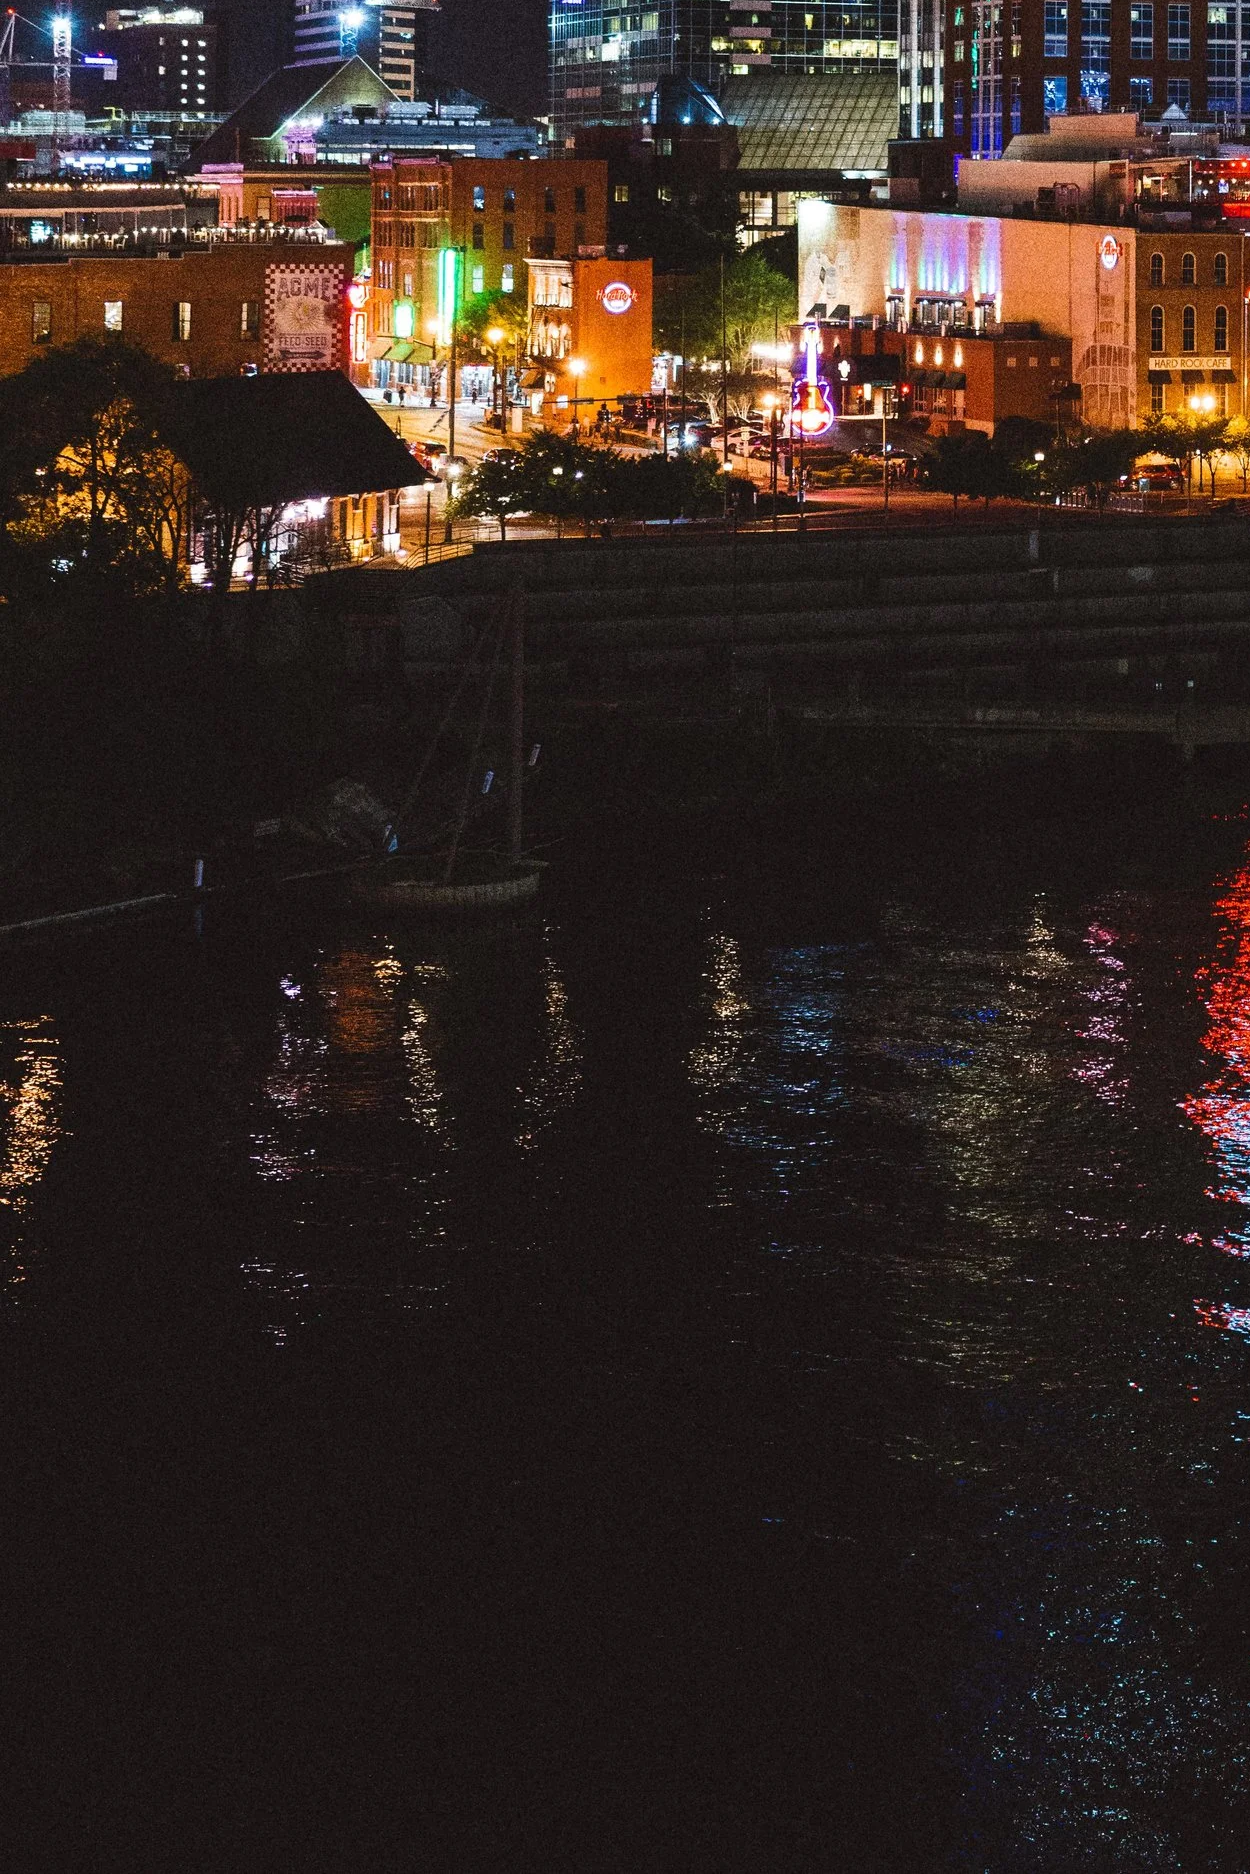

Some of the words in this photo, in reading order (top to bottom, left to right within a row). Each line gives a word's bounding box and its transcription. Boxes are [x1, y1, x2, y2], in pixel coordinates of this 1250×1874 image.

[276, 277, 331, 303] ACME
[280, 336, 301, 346] FEED
[305, 336, 328, 346] SEED
[1154, 358, 1179, 369] HARD
[1180, 358, 1205, 368] ROCK
[1206, 358, 1227, 369] CAFE
